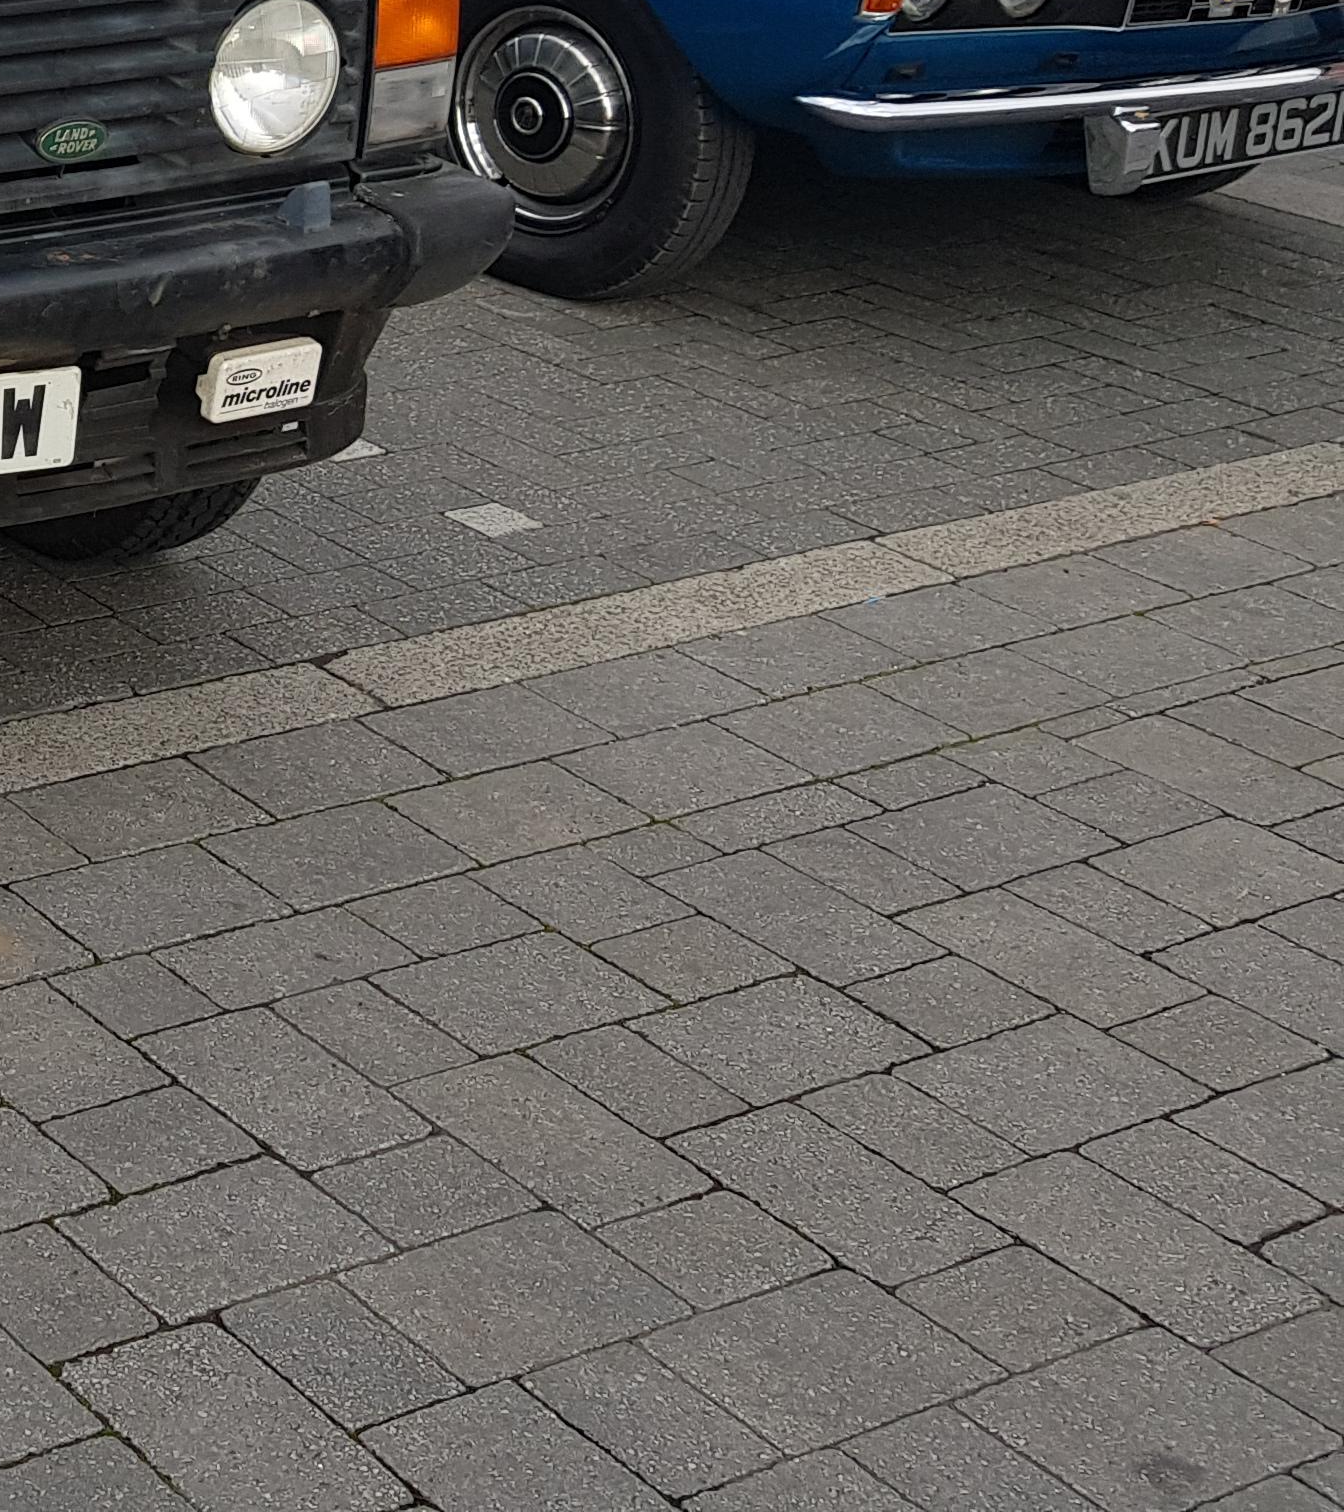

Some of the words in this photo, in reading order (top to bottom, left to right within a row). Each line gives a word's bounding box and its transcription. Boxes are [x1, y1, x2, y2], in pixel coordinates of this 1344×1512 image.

[1246, 92, 1344, 157] 862
[55, 128, 88, 143] LAND
[57, 138, 98, 155] ROVER
[232, 372, 257, 382] RING
[221, 378, 311, 408] microline
